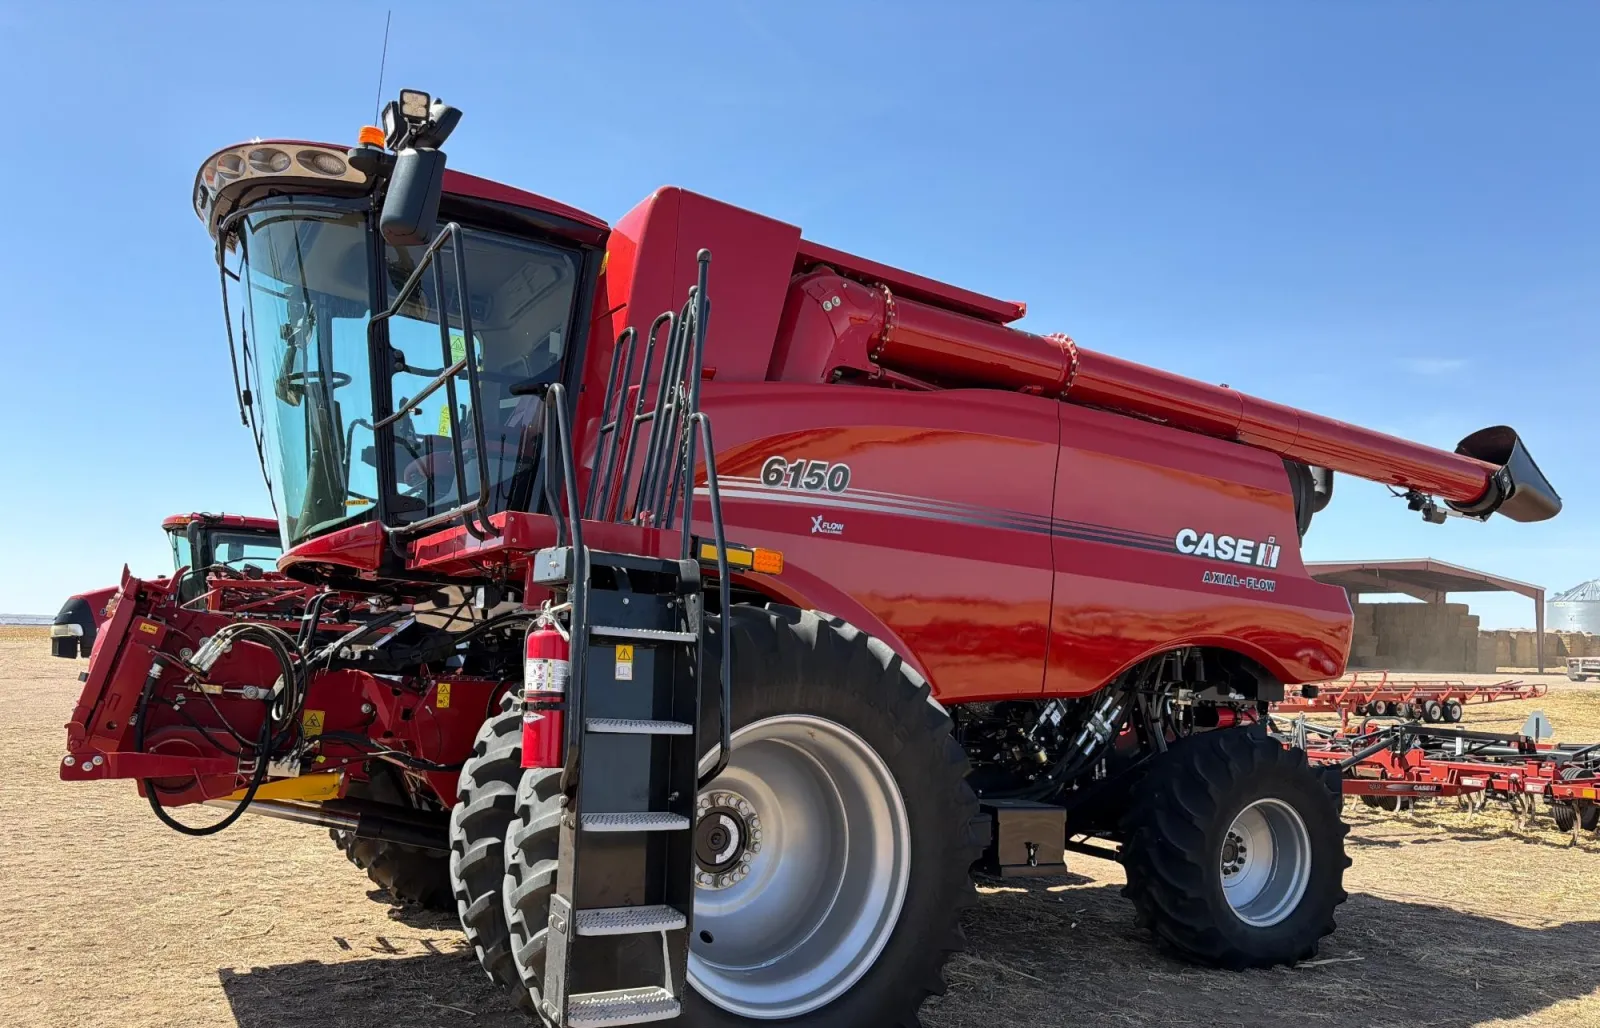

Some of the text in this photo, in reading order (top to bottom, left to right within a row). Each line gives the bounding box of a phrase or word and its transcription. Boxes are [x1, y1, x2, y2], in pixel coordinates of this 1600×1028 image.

[761, 456, 851, 493] 6150
[822, 522, 843, 530] FLOW
[1175, 528, 1255, 564] CASE
